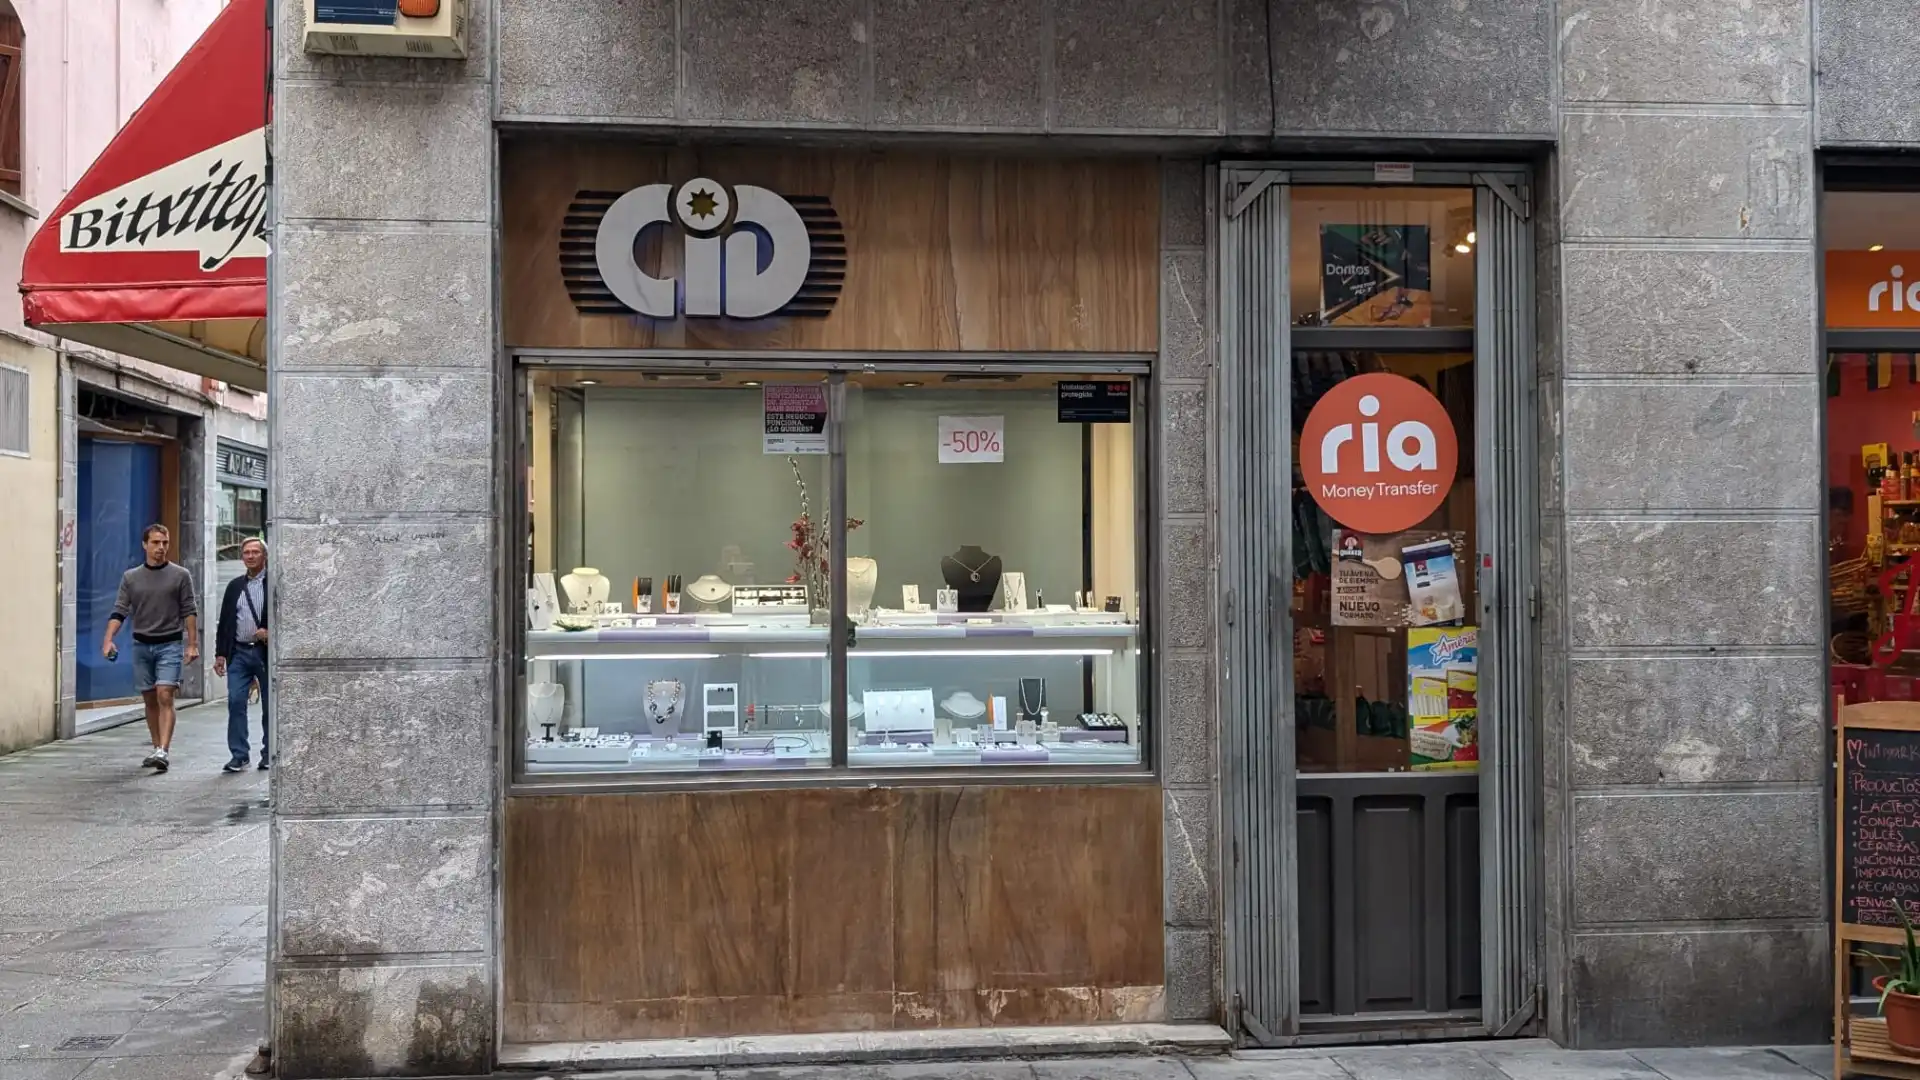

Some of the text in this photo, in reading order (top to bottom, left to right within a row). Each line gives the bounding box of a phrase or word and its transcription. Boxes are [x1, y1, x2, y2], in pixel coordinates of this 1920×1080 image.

[1326, 263, 1370, 275] Doritos
[942, 430, 1000, 454] -50%
[1321, 394, 1437, 474] ria
[1322, 480, 1439, 500] Money Transfer
[1340, 601, 1380, 612] NUEVO
